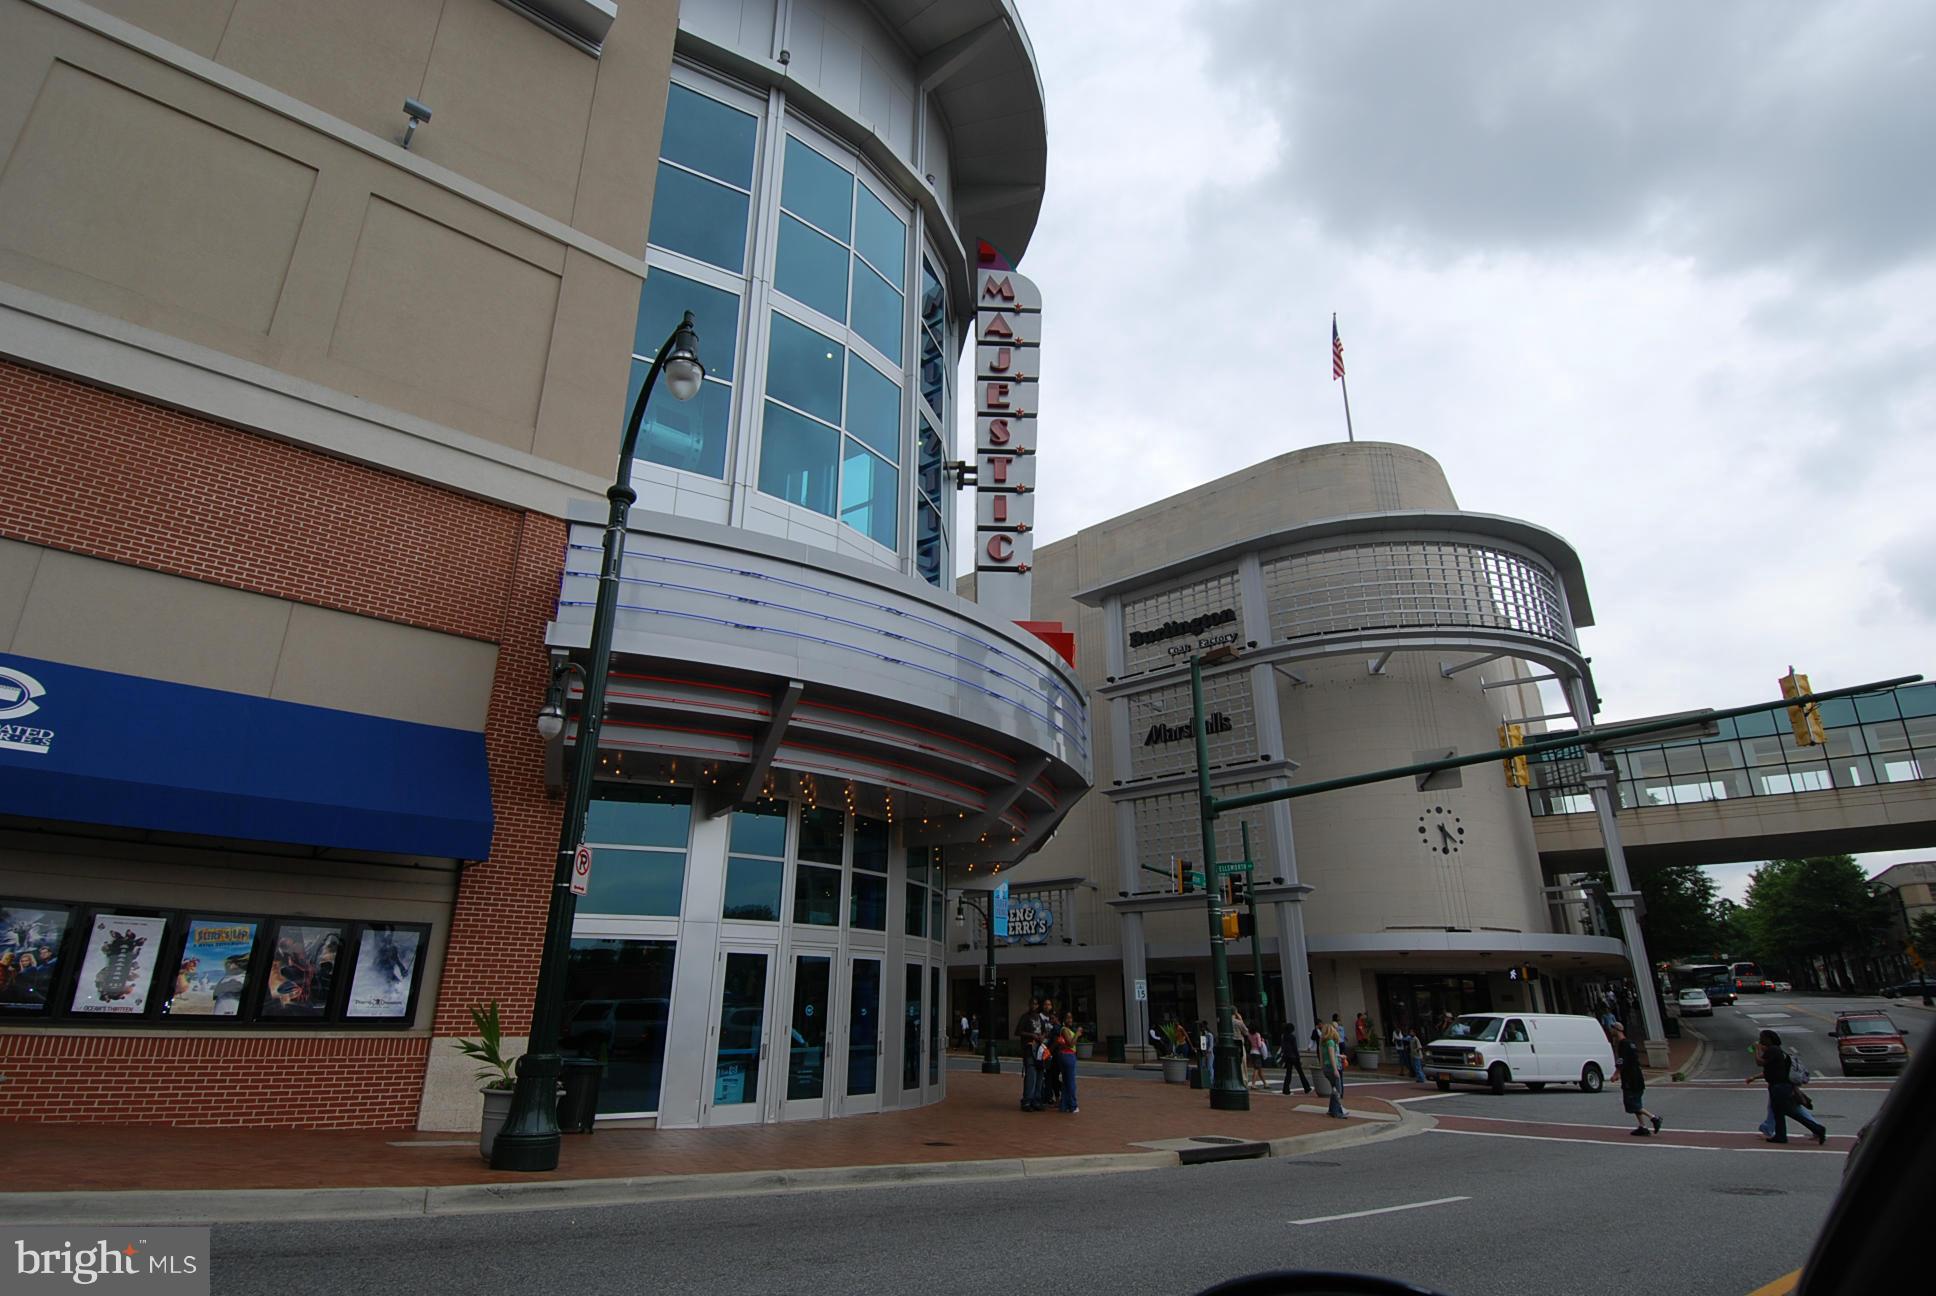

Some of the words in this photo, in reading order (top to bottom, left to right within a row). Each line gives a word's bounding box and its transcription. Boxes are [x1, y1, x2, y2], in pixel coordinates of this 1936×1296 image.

[982, 274, 1016, 564] MAJESTIC
[1129, 608, 1237, 648] Burlington
[1198, 632, 1238, 648] Factory
[0, 724, 55, 739] ATED
[1144, 711, 1232, 746] Marslls
[1219, 863, 1247, 872] ELLSWORTH
[1008, 919, 1047, 935] ERRY'S
[1137, 989, 1146, 999] 15
